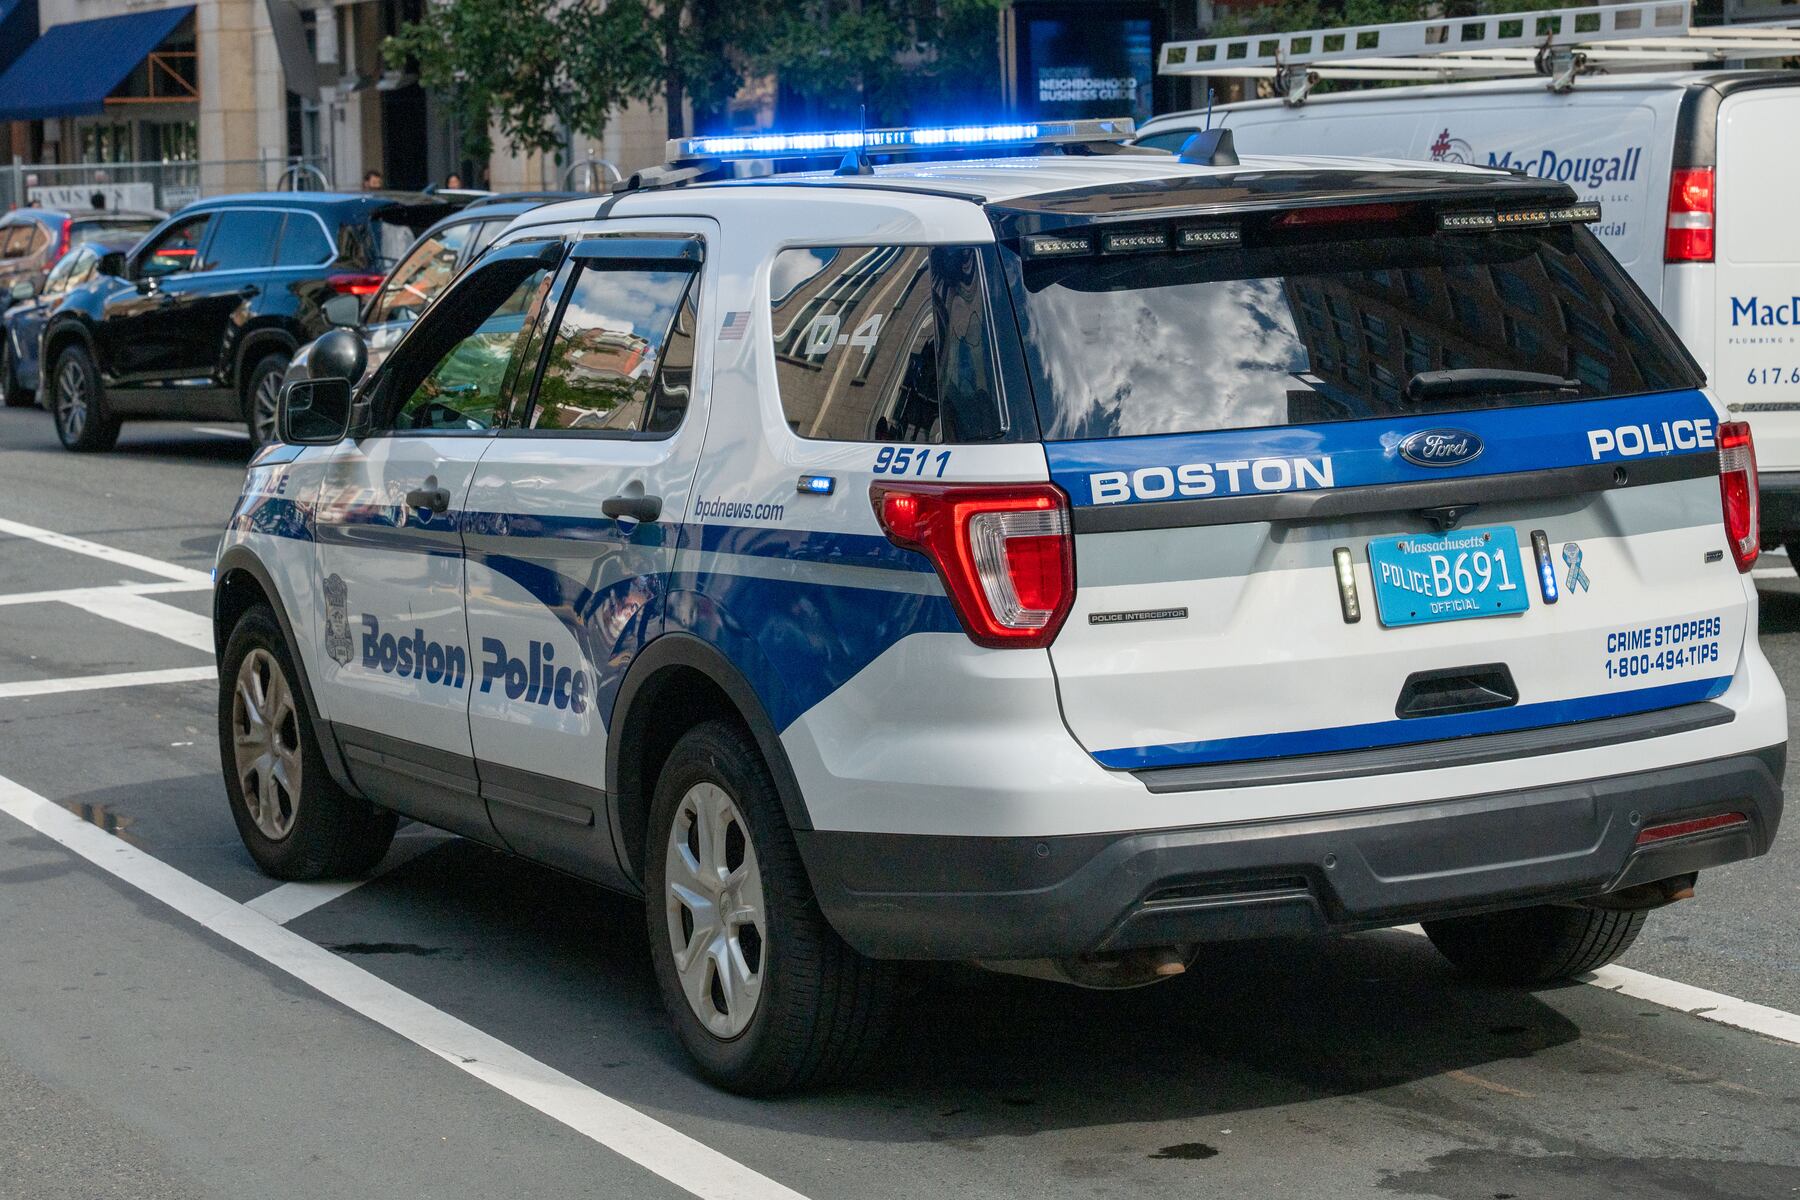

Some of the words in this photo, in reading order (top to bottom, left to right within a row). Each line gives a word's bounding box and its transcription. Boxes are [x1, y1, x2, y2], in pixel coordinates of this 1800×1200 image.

[1039, 79, 1138, 90] NEIGHBORHOOD
[1039, 90, 1098, 101] BUSINESS
[1099, 89, 1137, 100] GUIDE
[804, 313, 884, 355] D-4
[1728, 337, 1784, 345] PLUMBING
[1422, 434, 1468, 458] Ford
[1587, 418, 1716, 461] POLICE
[872, 446, 952, 478] 9511
[1089, 456, 1335, 505] BOSTON
[694, 494, 785, 522] bpdnews.com
[1404, 536, 1486, 555] Massachusetts
[1380, 560, 1433, 597] POLICE
[1429, 548, 1517, 598] B691
[1091, 613, 1123, 623] POLICE
[1125, 609, 1186, 621] INTERCEPTOR
[1430, 598, 1480, 614] OFFICIAL
[1607, 628, 1652, 654] CRIME
[1654, 616, 1721, 647] STOPPERS
[362, 613, 466, 689] Boston
[479, 636, 590, 715] Police
[1605, 642, 1719, 680] 1-800-494-TIPS
